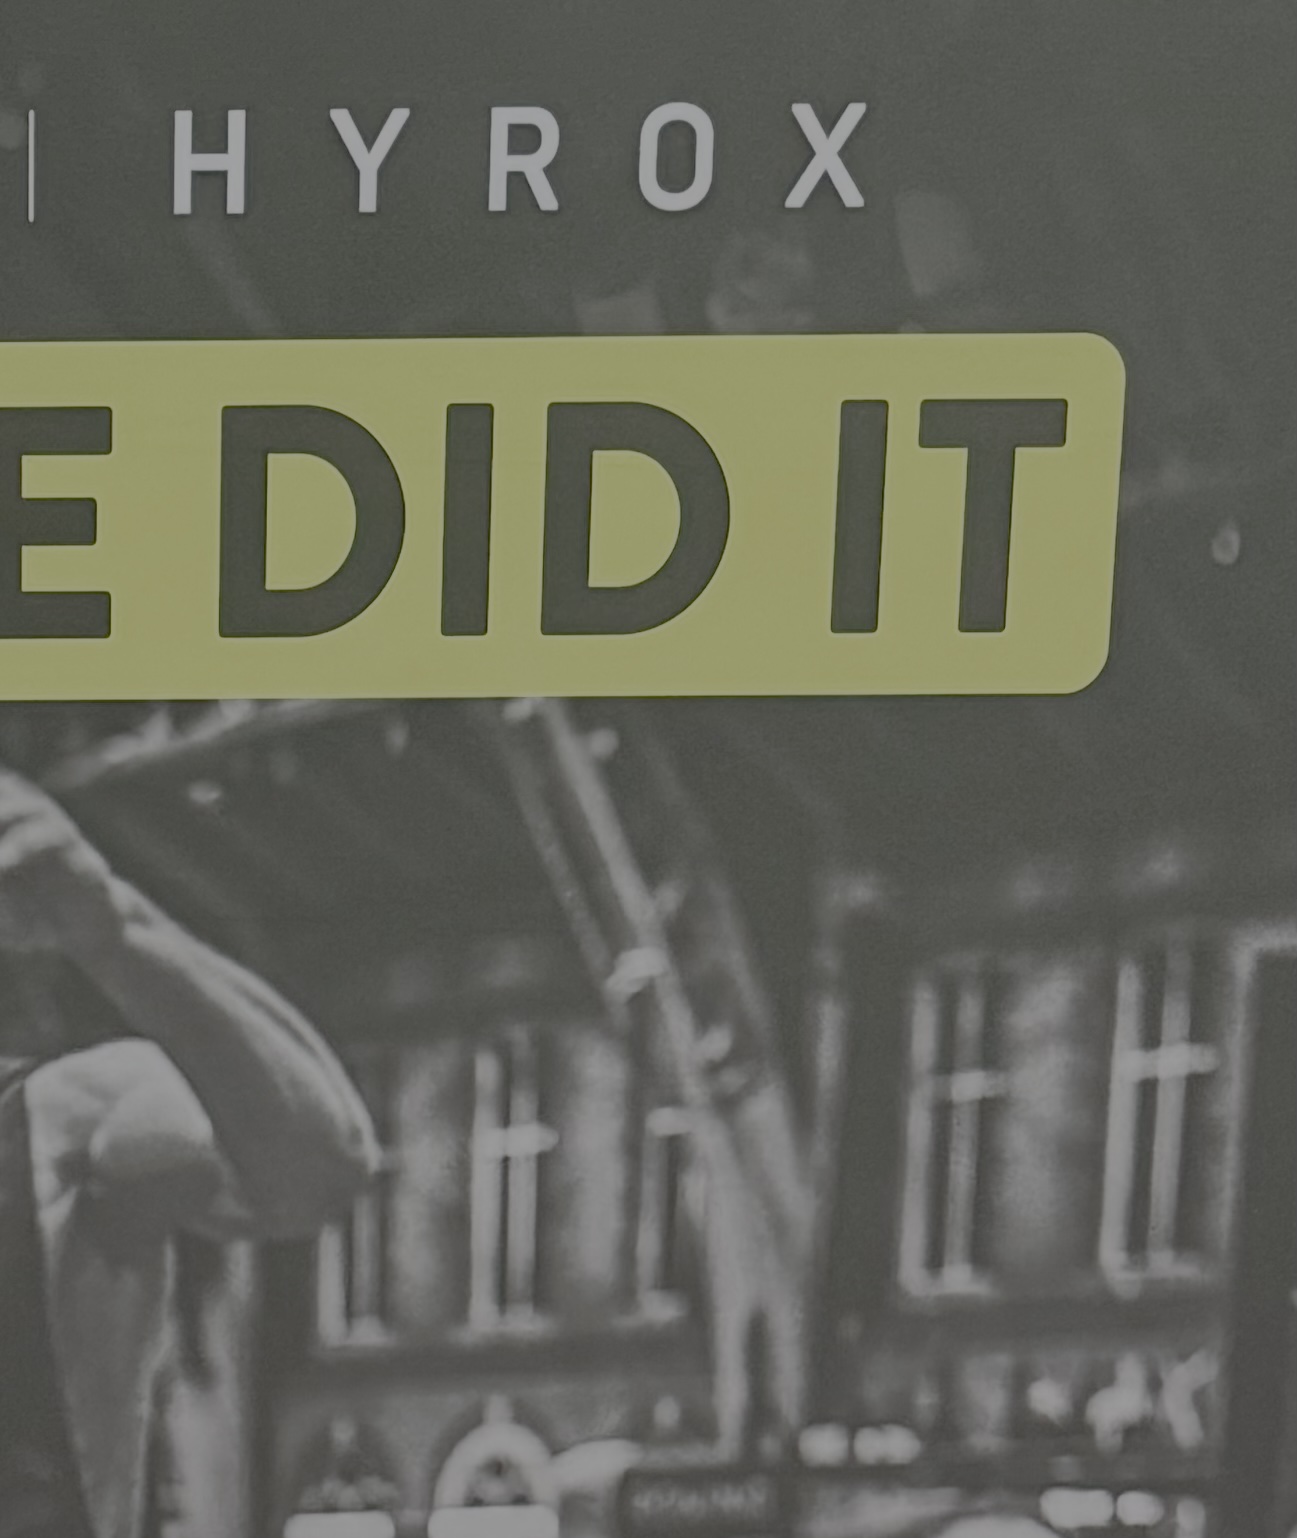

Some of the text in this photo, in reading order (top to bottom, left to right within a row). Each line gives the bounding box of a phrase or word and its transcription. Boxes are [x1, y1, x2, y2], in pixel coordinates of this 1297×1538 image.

[172, 101, 867, 216] HYROX
[217, 400, 731, 638] DID
[829, 397, 1068, 634] IT
